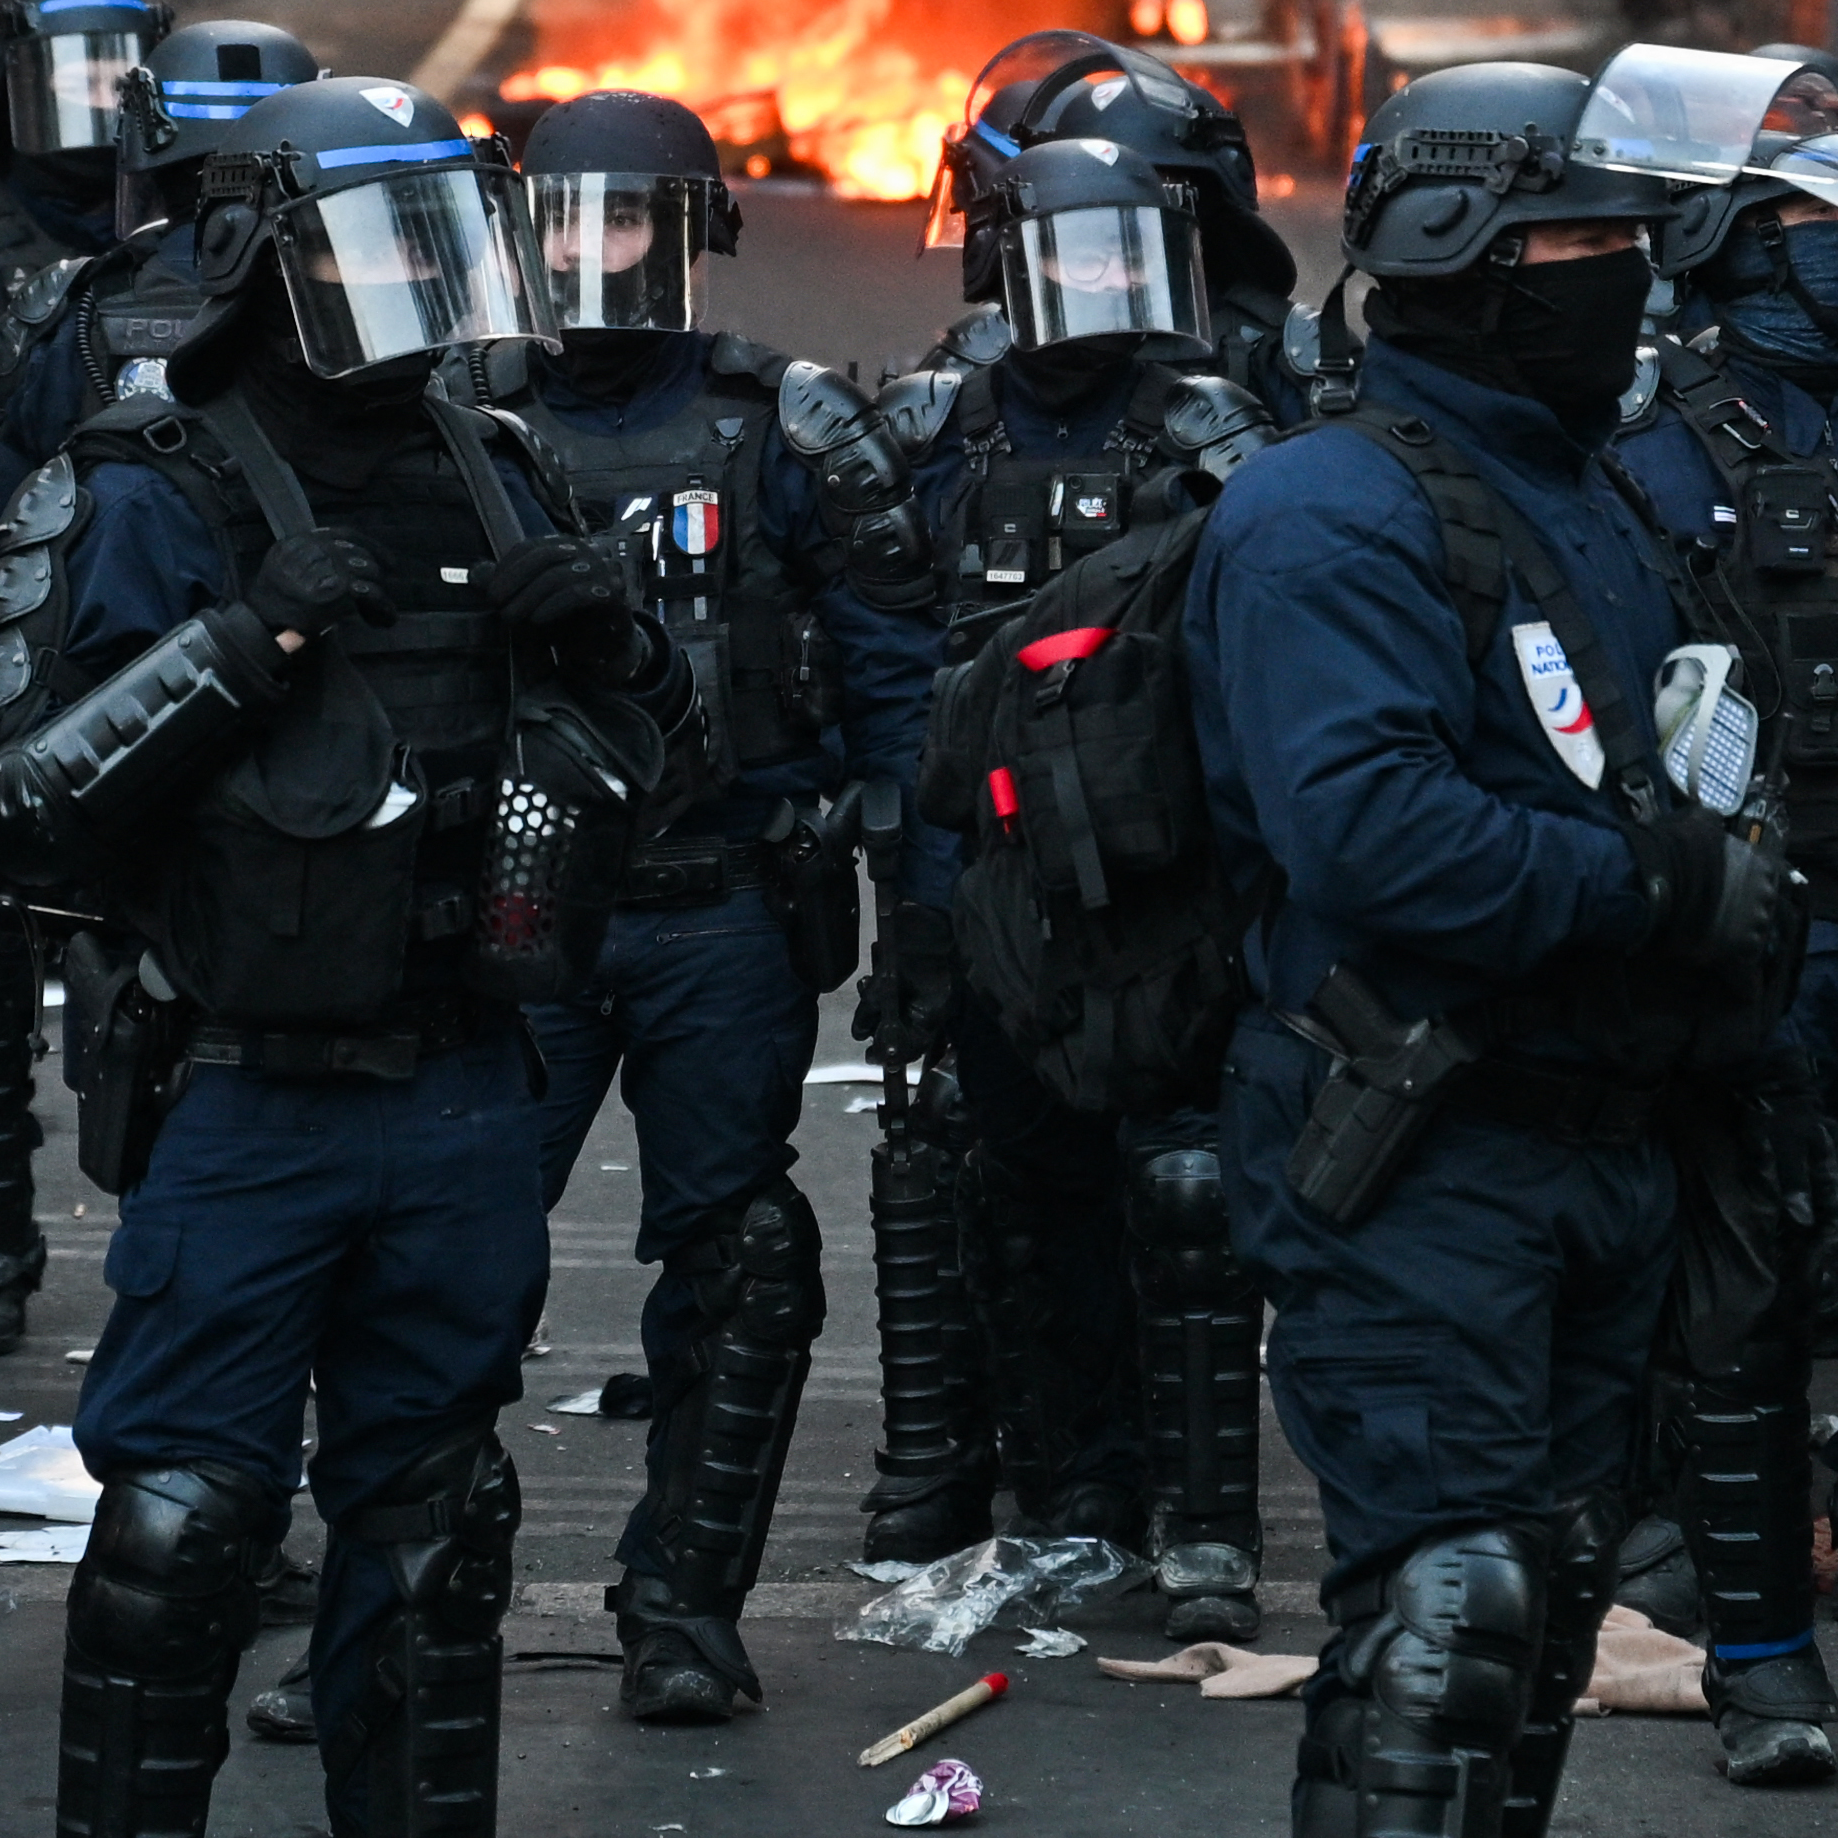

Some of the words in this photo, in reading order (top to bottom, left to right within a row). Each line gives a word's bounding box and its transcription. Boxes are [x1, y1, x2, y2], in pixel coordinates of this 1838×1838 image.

[676, 492, 715, 504] FRANCE
[1535, 643, 1564, 657] POL
[1531, 660, 1570, 675] NATIO
